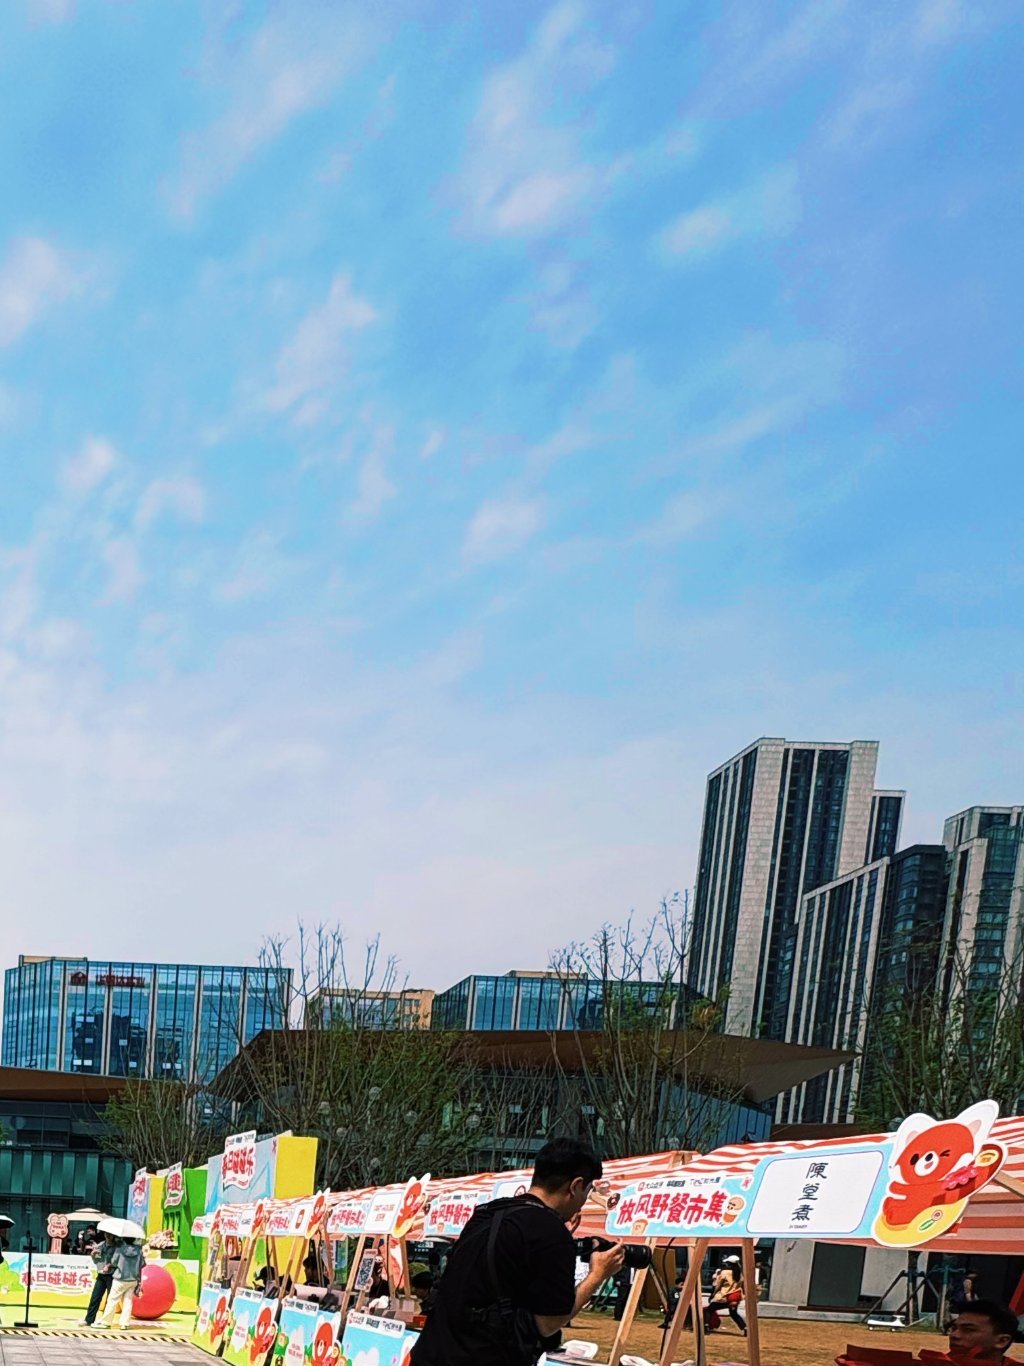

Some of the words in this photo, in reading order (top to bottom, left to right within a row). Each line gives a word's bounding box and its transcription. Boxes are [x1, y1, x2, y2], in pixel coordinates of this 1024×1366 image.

[616, 1190, 727, 1225] 放风野餐市集
[791, 1162, 828, 1221] 陳堂煮
[430, 1203, 478, 1225] 放风野餐市
